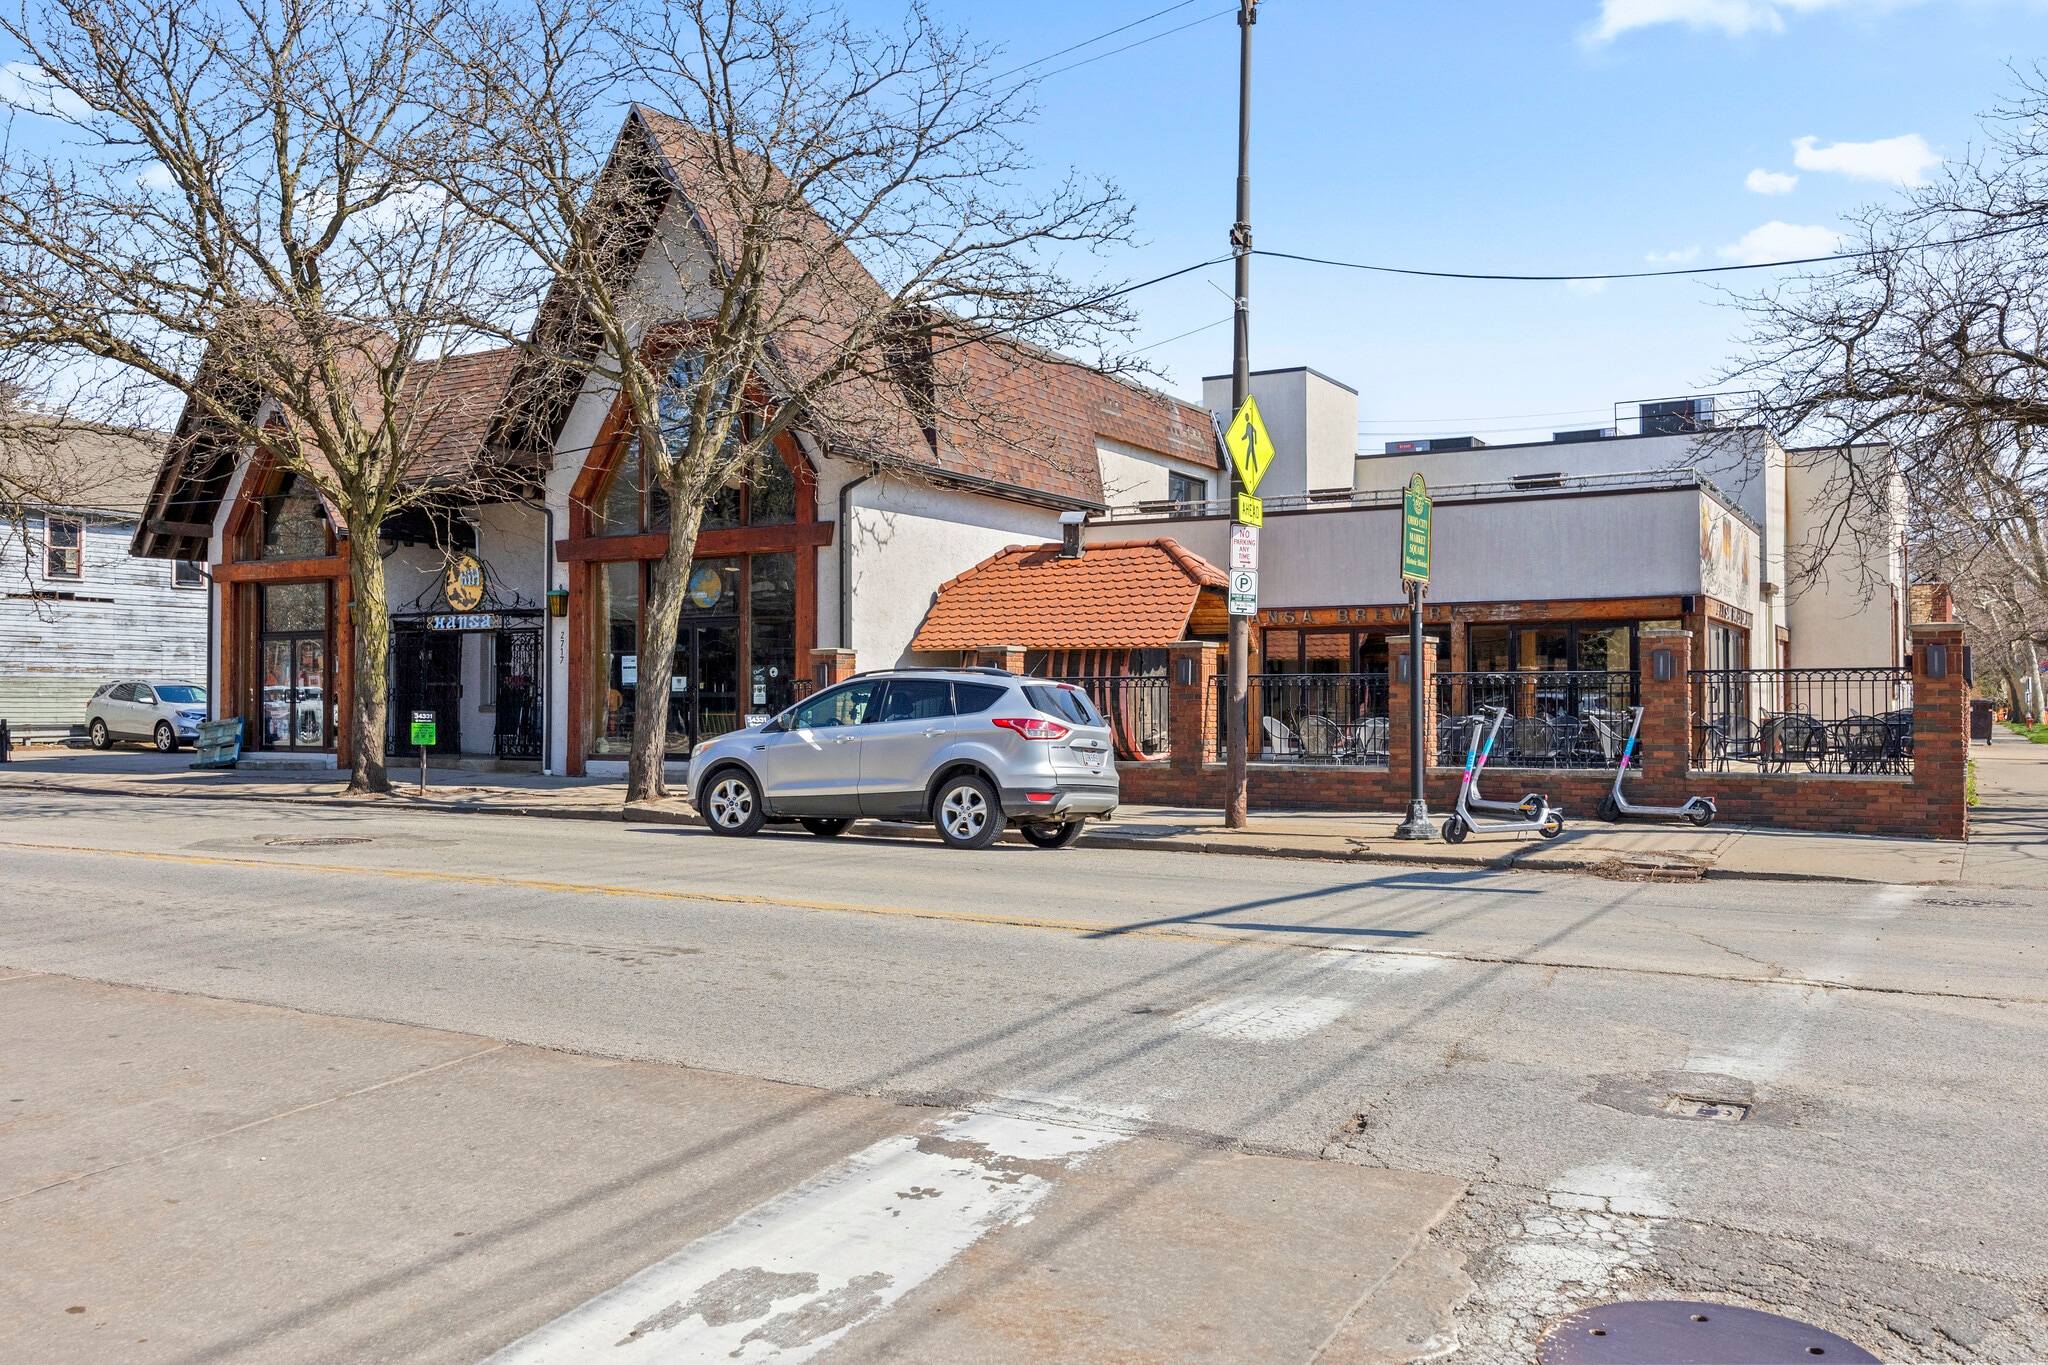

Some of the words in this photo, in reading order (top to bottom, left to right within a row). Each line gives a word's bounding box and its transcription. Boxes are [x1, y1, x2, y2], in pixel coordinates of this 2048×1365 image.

[1242, 501, 1259, 519] AHEAD
[1239, 530, 1250, 538] NO
[1409, 531, 1426, 545] MARKET
[1233, 538, 1255, 546] PARKING
[1409, 544, 1425, 556] SQUARE
[1240, 577, 1249, 589] P
[1250, 609, 1314, 625] ANSA
[1337, 605, 1460, 623] BREWRY
